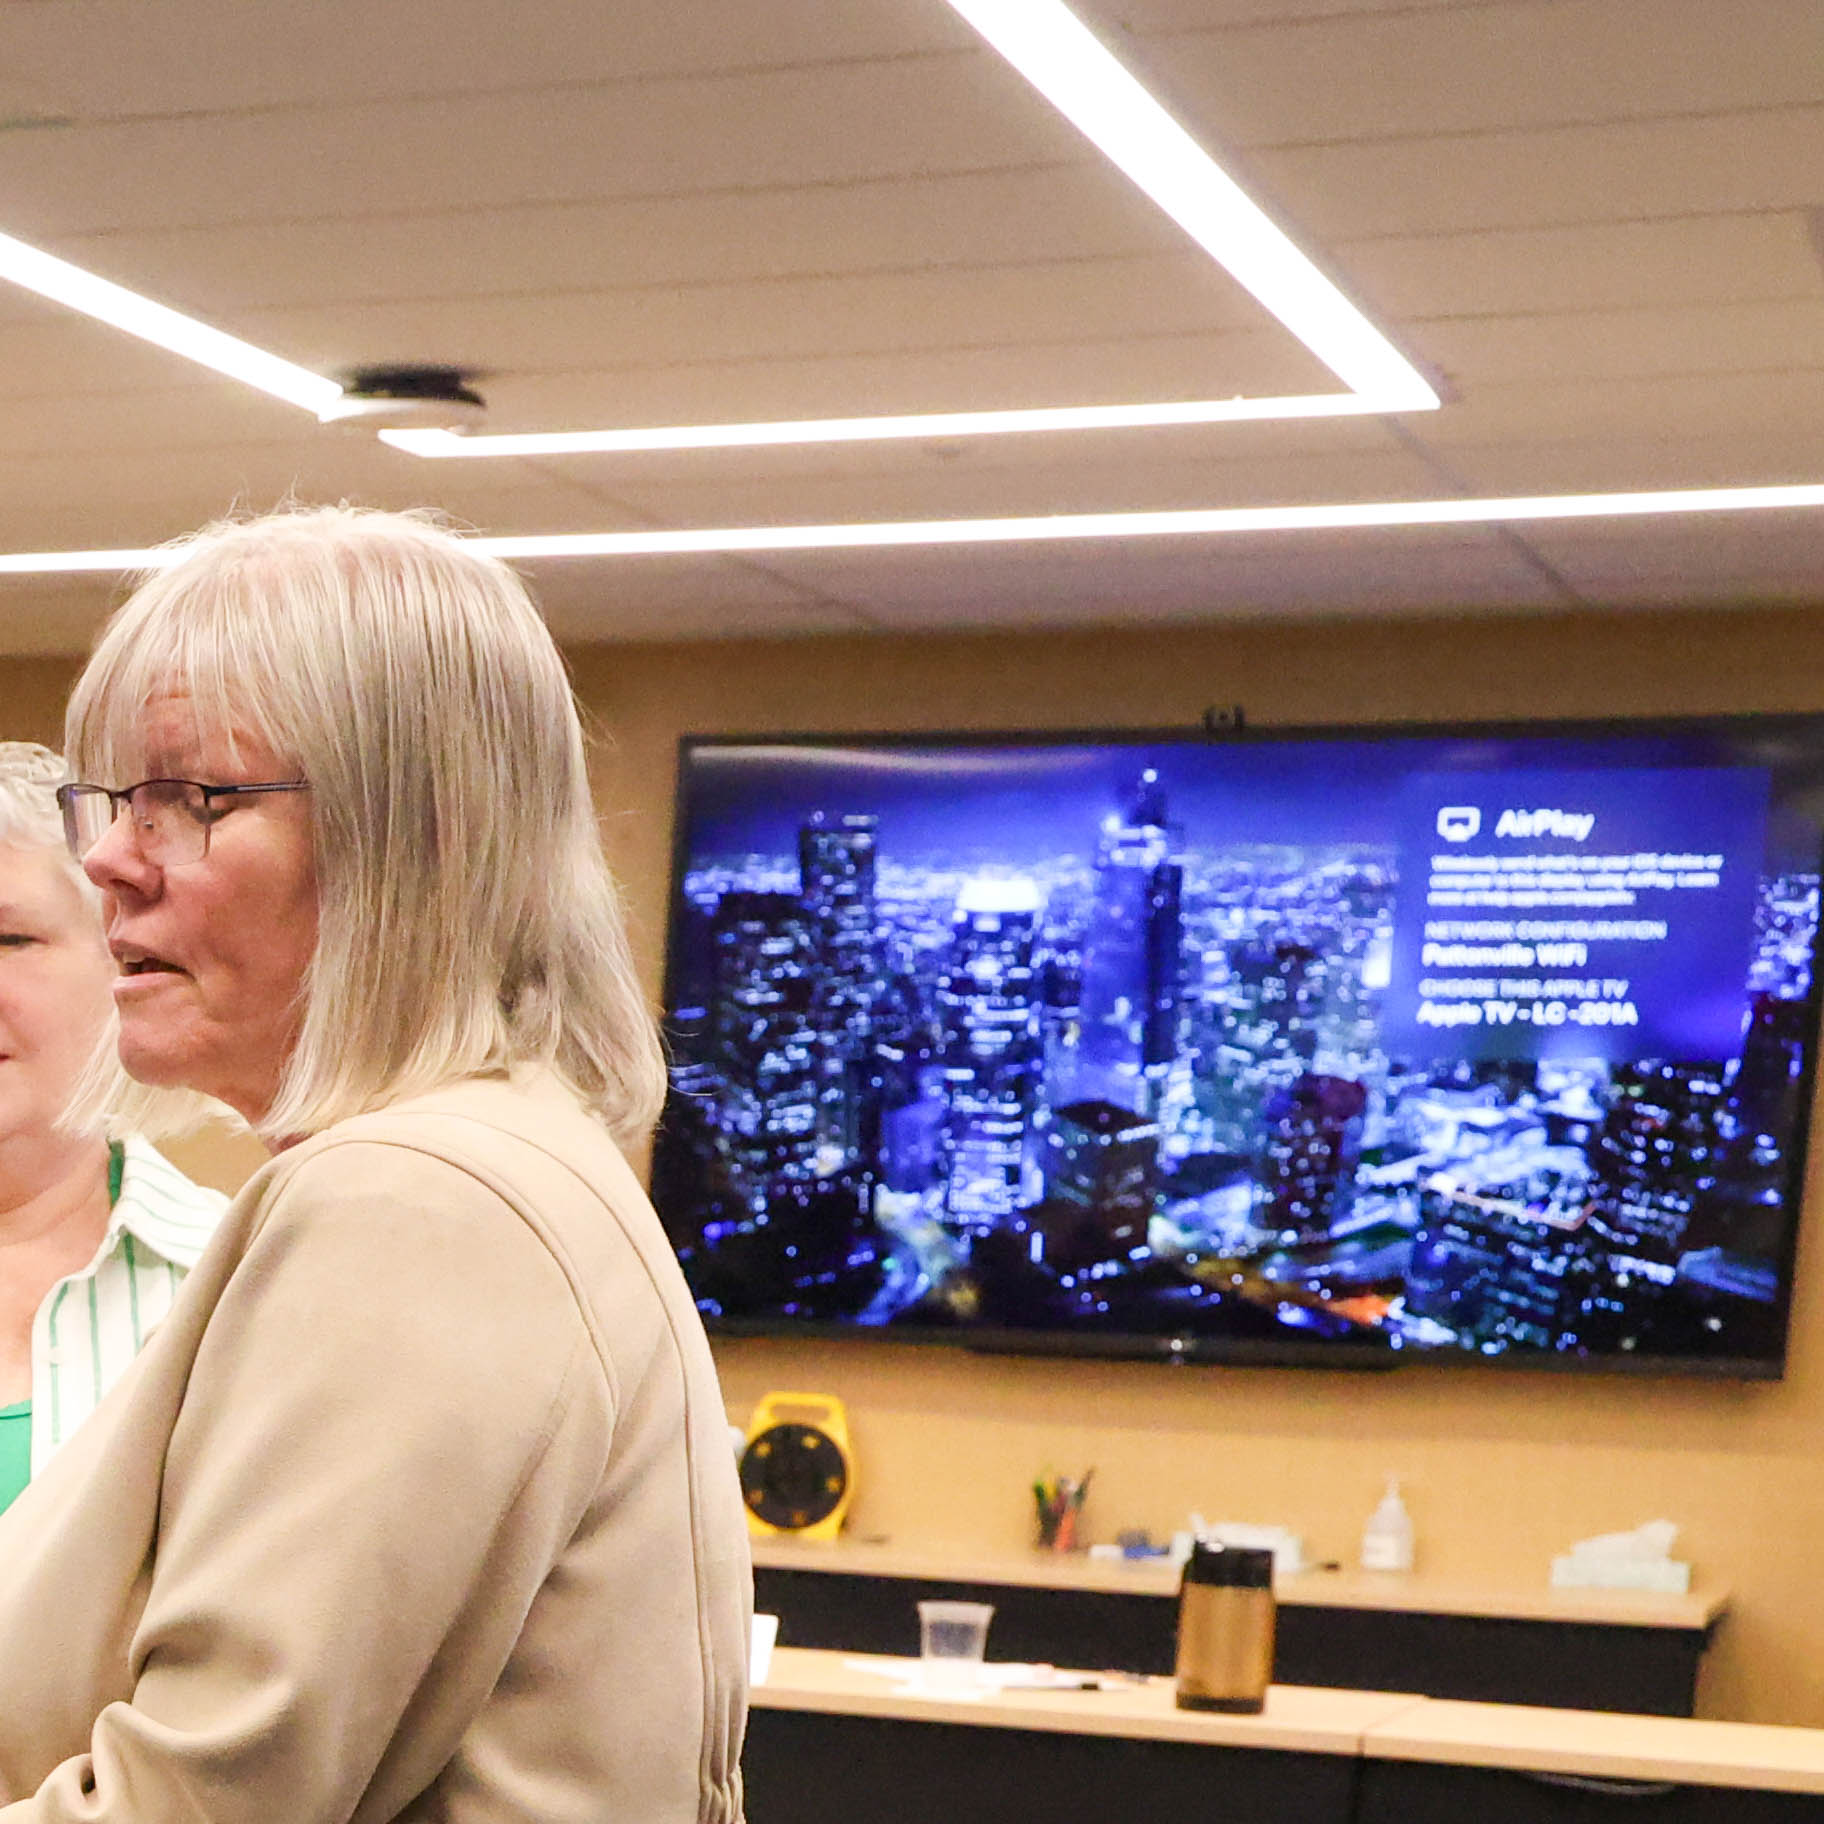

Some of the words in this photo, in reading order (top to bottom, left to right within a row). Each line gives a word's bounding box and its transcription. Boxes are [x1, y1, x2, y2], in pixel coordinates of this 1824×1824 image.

[1494, 809, 1595, 842] AirPlay
[1602, 979, 1629, 1000] TV
[1416, 1000, 1482, 1028] Apple
[1482, 1001, 1518, 1025] TV
